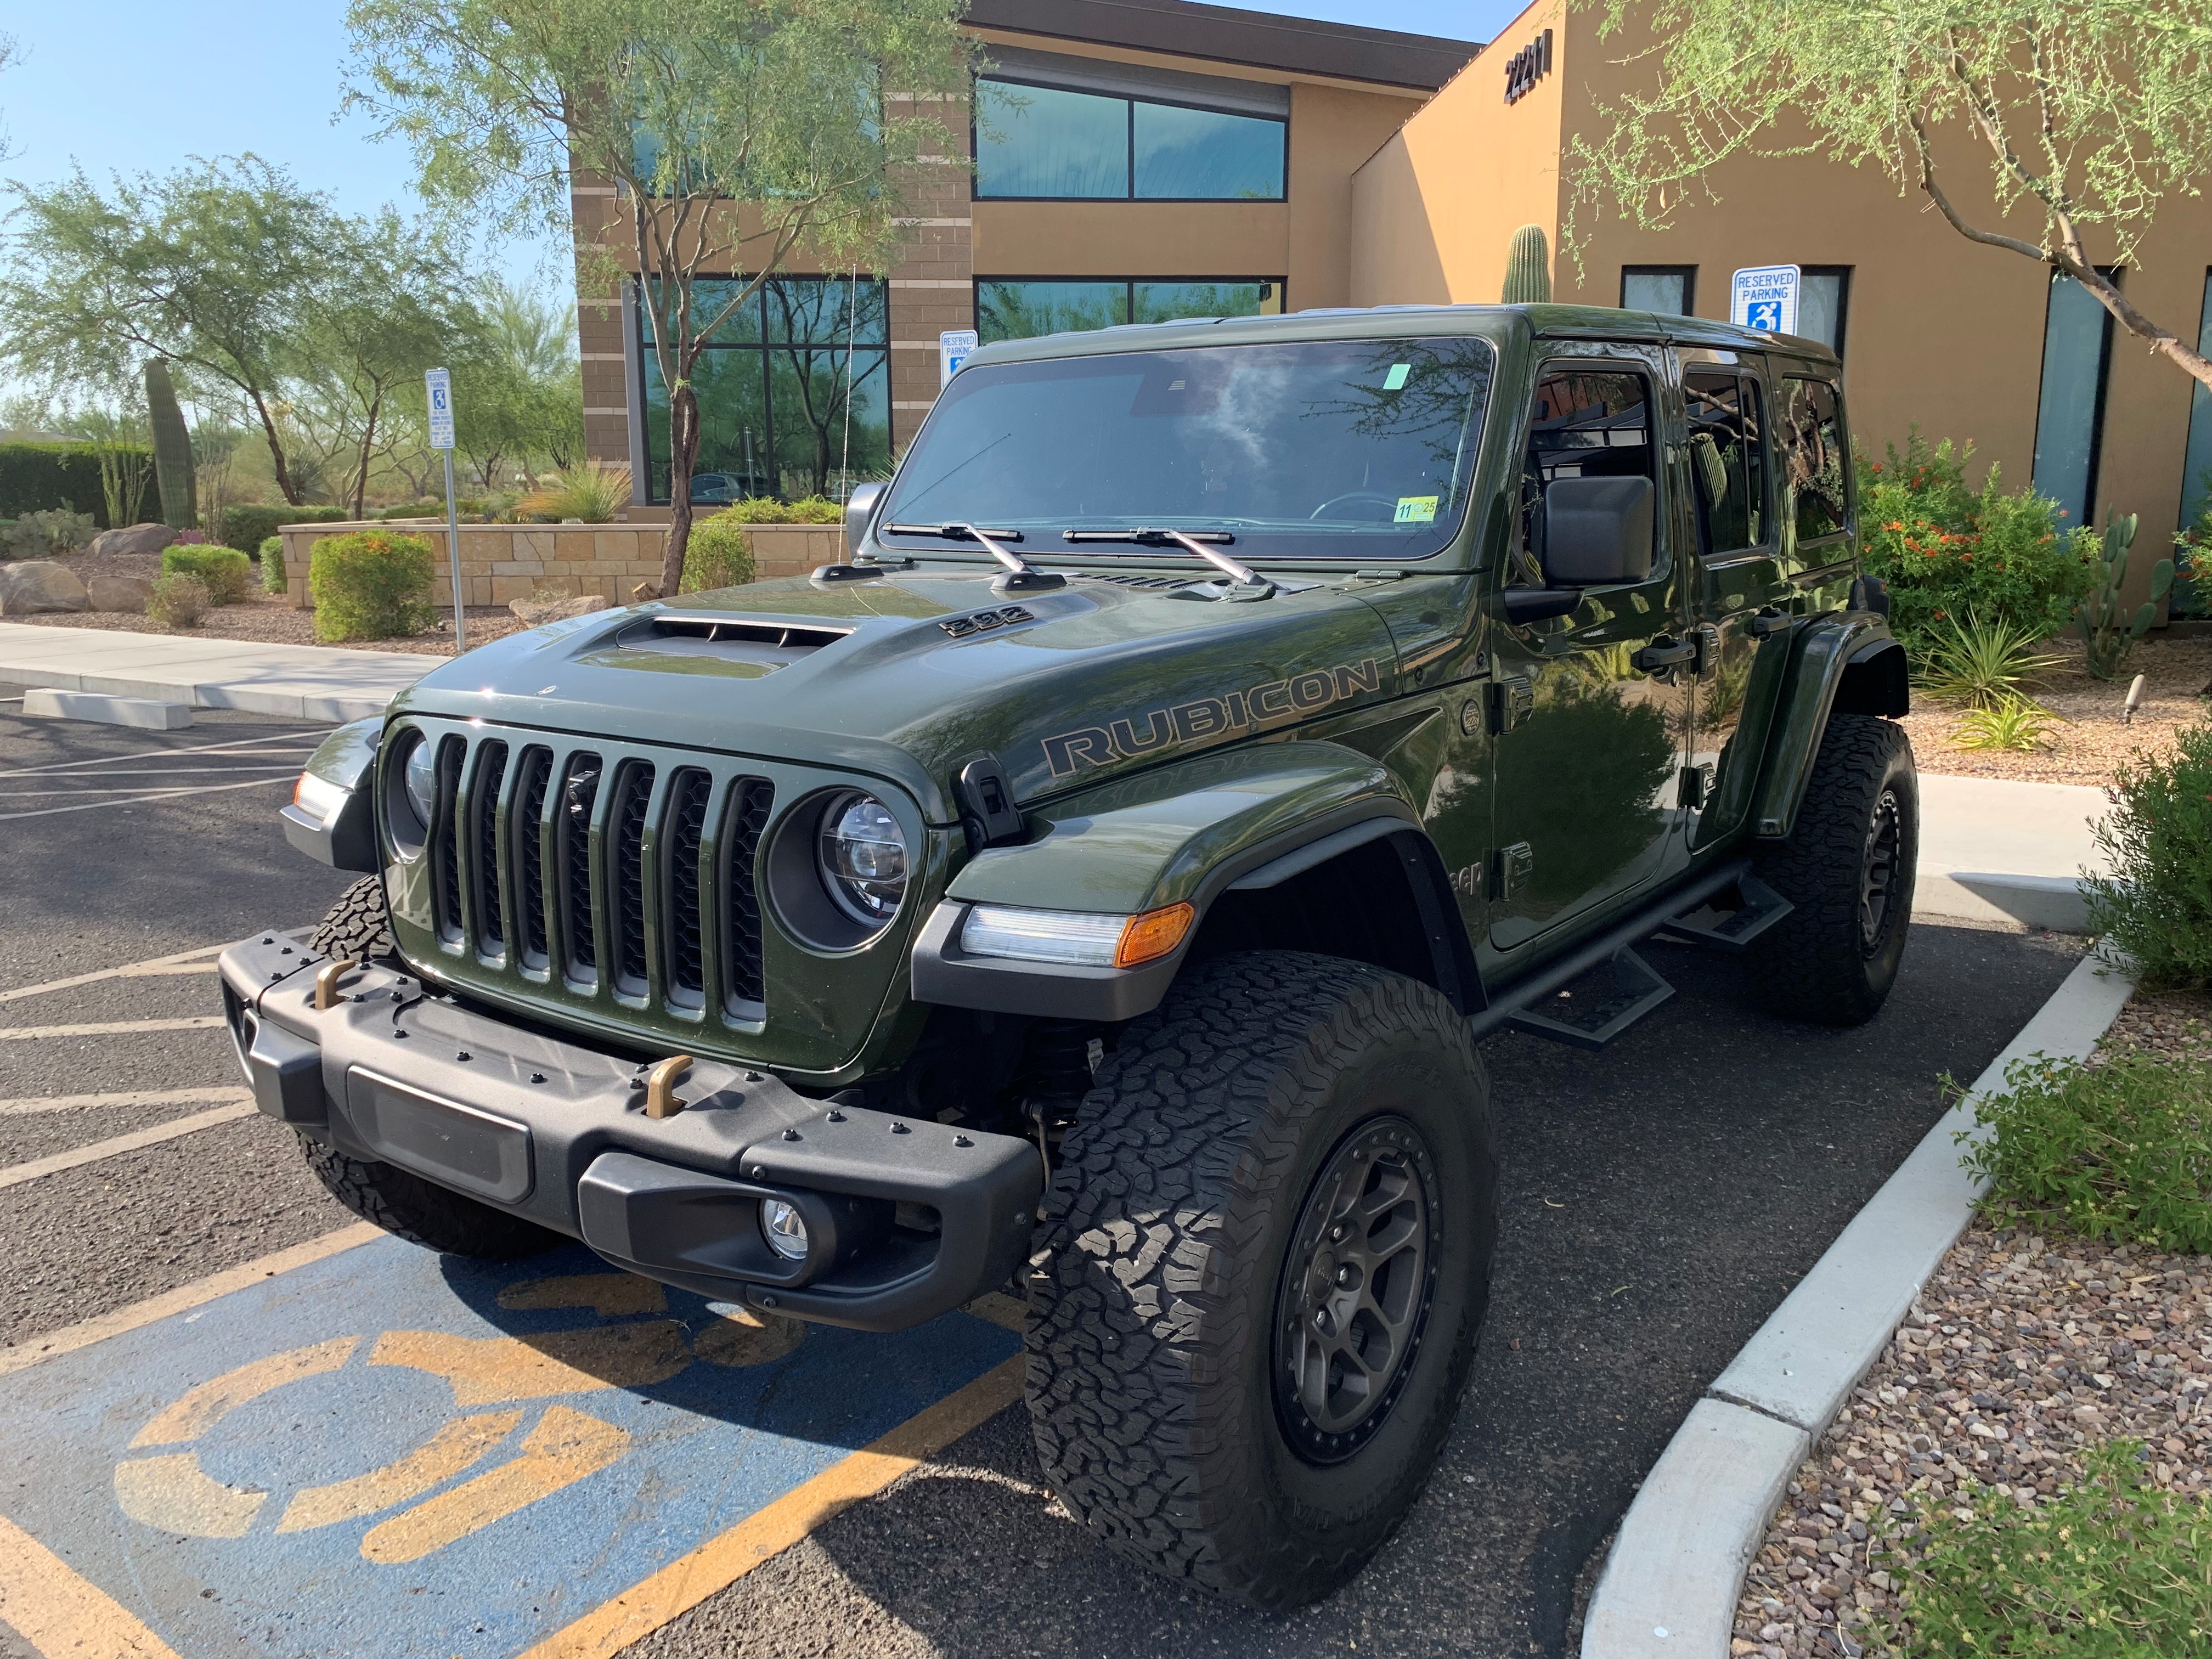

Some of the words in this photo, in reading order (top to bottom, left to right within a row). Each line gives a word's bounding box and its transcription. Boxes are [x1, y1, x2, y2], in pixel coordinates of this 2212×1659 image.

[1739, 273, 1794, 288] RESERVED
[1743, 287, 1788, 301] PARKING
[944, 336, 974, 346] RESERVED
[1400, 504, 1412, 518] 11
[1423, 502, 1435, 512] 25
[938, 606, 1034, 637] 392
[1040, 658, 1380, 778] RUBICON
